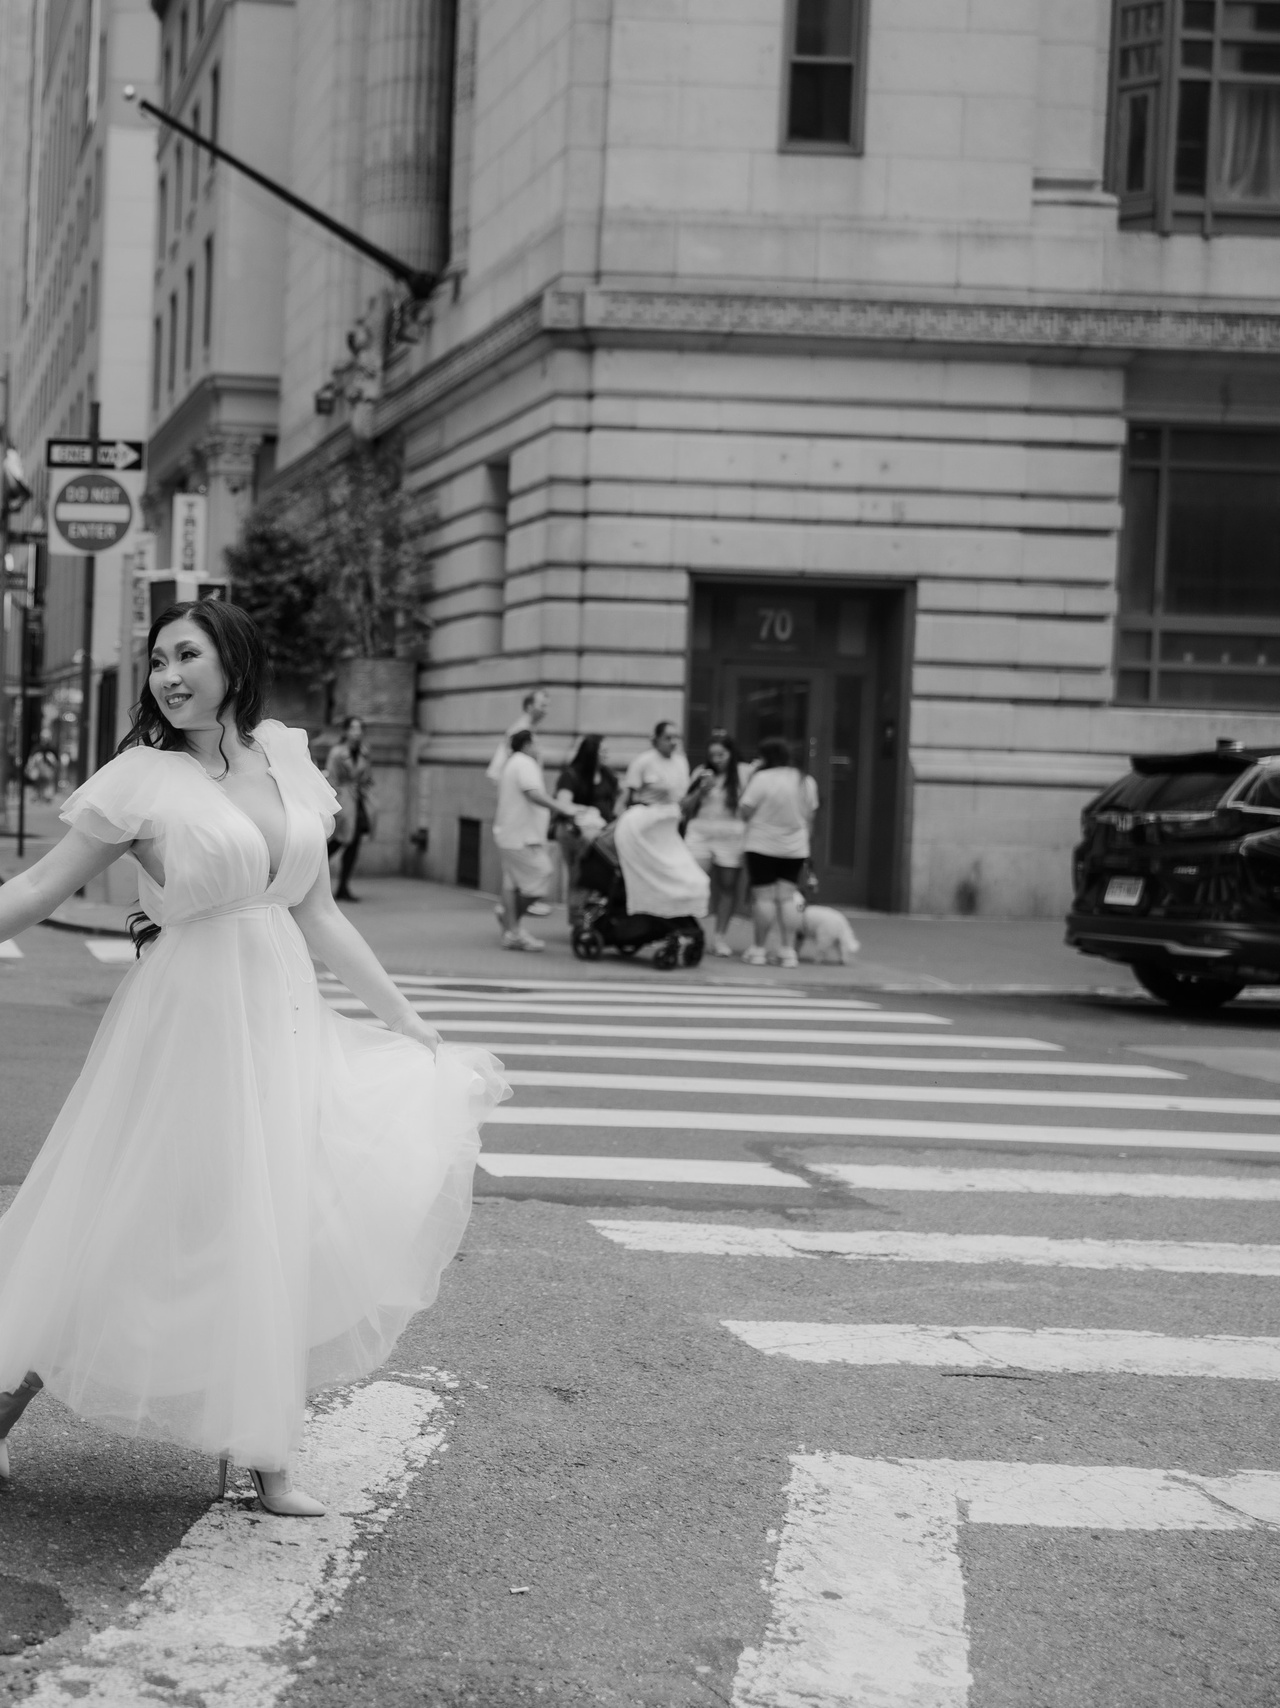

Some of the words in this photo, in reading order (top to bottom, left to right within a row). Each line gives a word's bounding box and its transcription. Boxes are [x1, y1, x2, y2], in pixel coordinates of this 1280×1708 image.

[58, 447, 87, 462] ONE
[65, 486, 88, 502] DO
[90, 486, 120, 503] NOT
[67, 522, 117, 539] ENTER
[758, 608, 793, 641] 70
